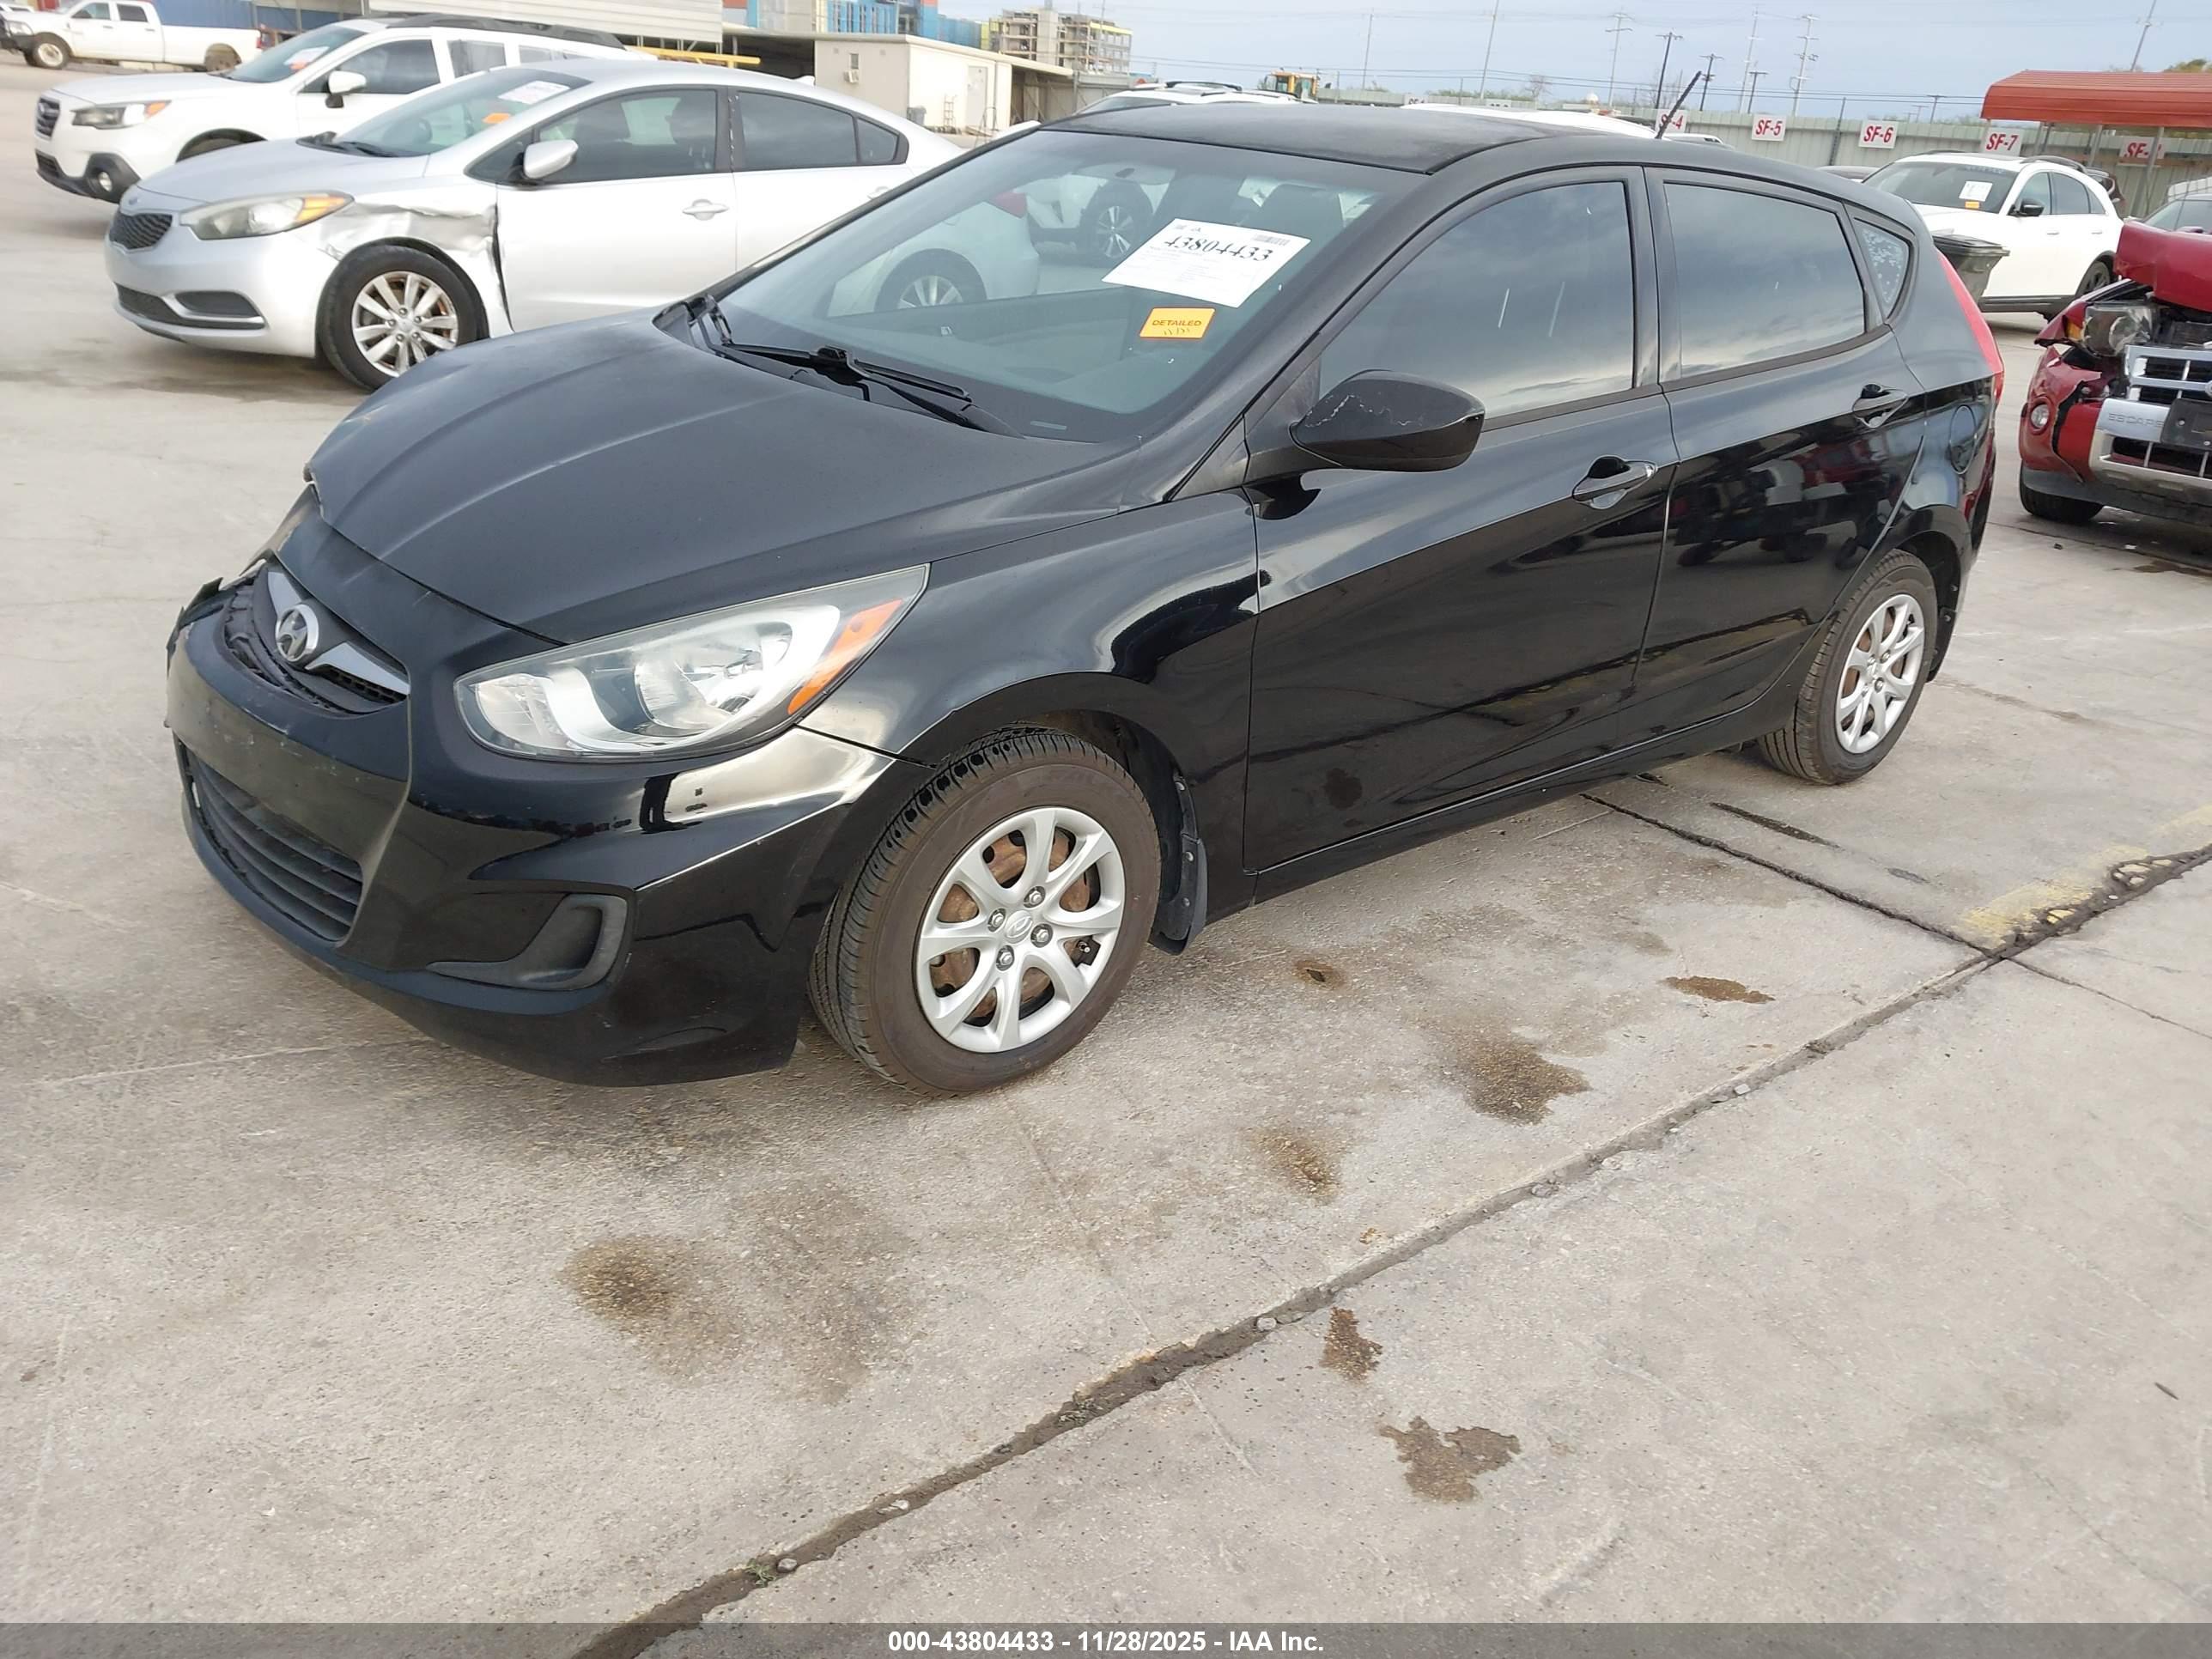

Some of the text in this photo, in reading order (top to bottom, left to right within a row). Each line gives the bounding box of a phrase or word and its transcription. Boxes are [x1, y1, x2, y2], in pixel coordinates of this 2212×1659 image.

[1755, 118, 1783, 137] SF-5
[1863, 125, 1893, 143] SF-6
[1985, 133, 2018, 151] SF-7
[2124, 142, 2162, 157] SF-
[1164, 235, 1273, 262] 43804433
